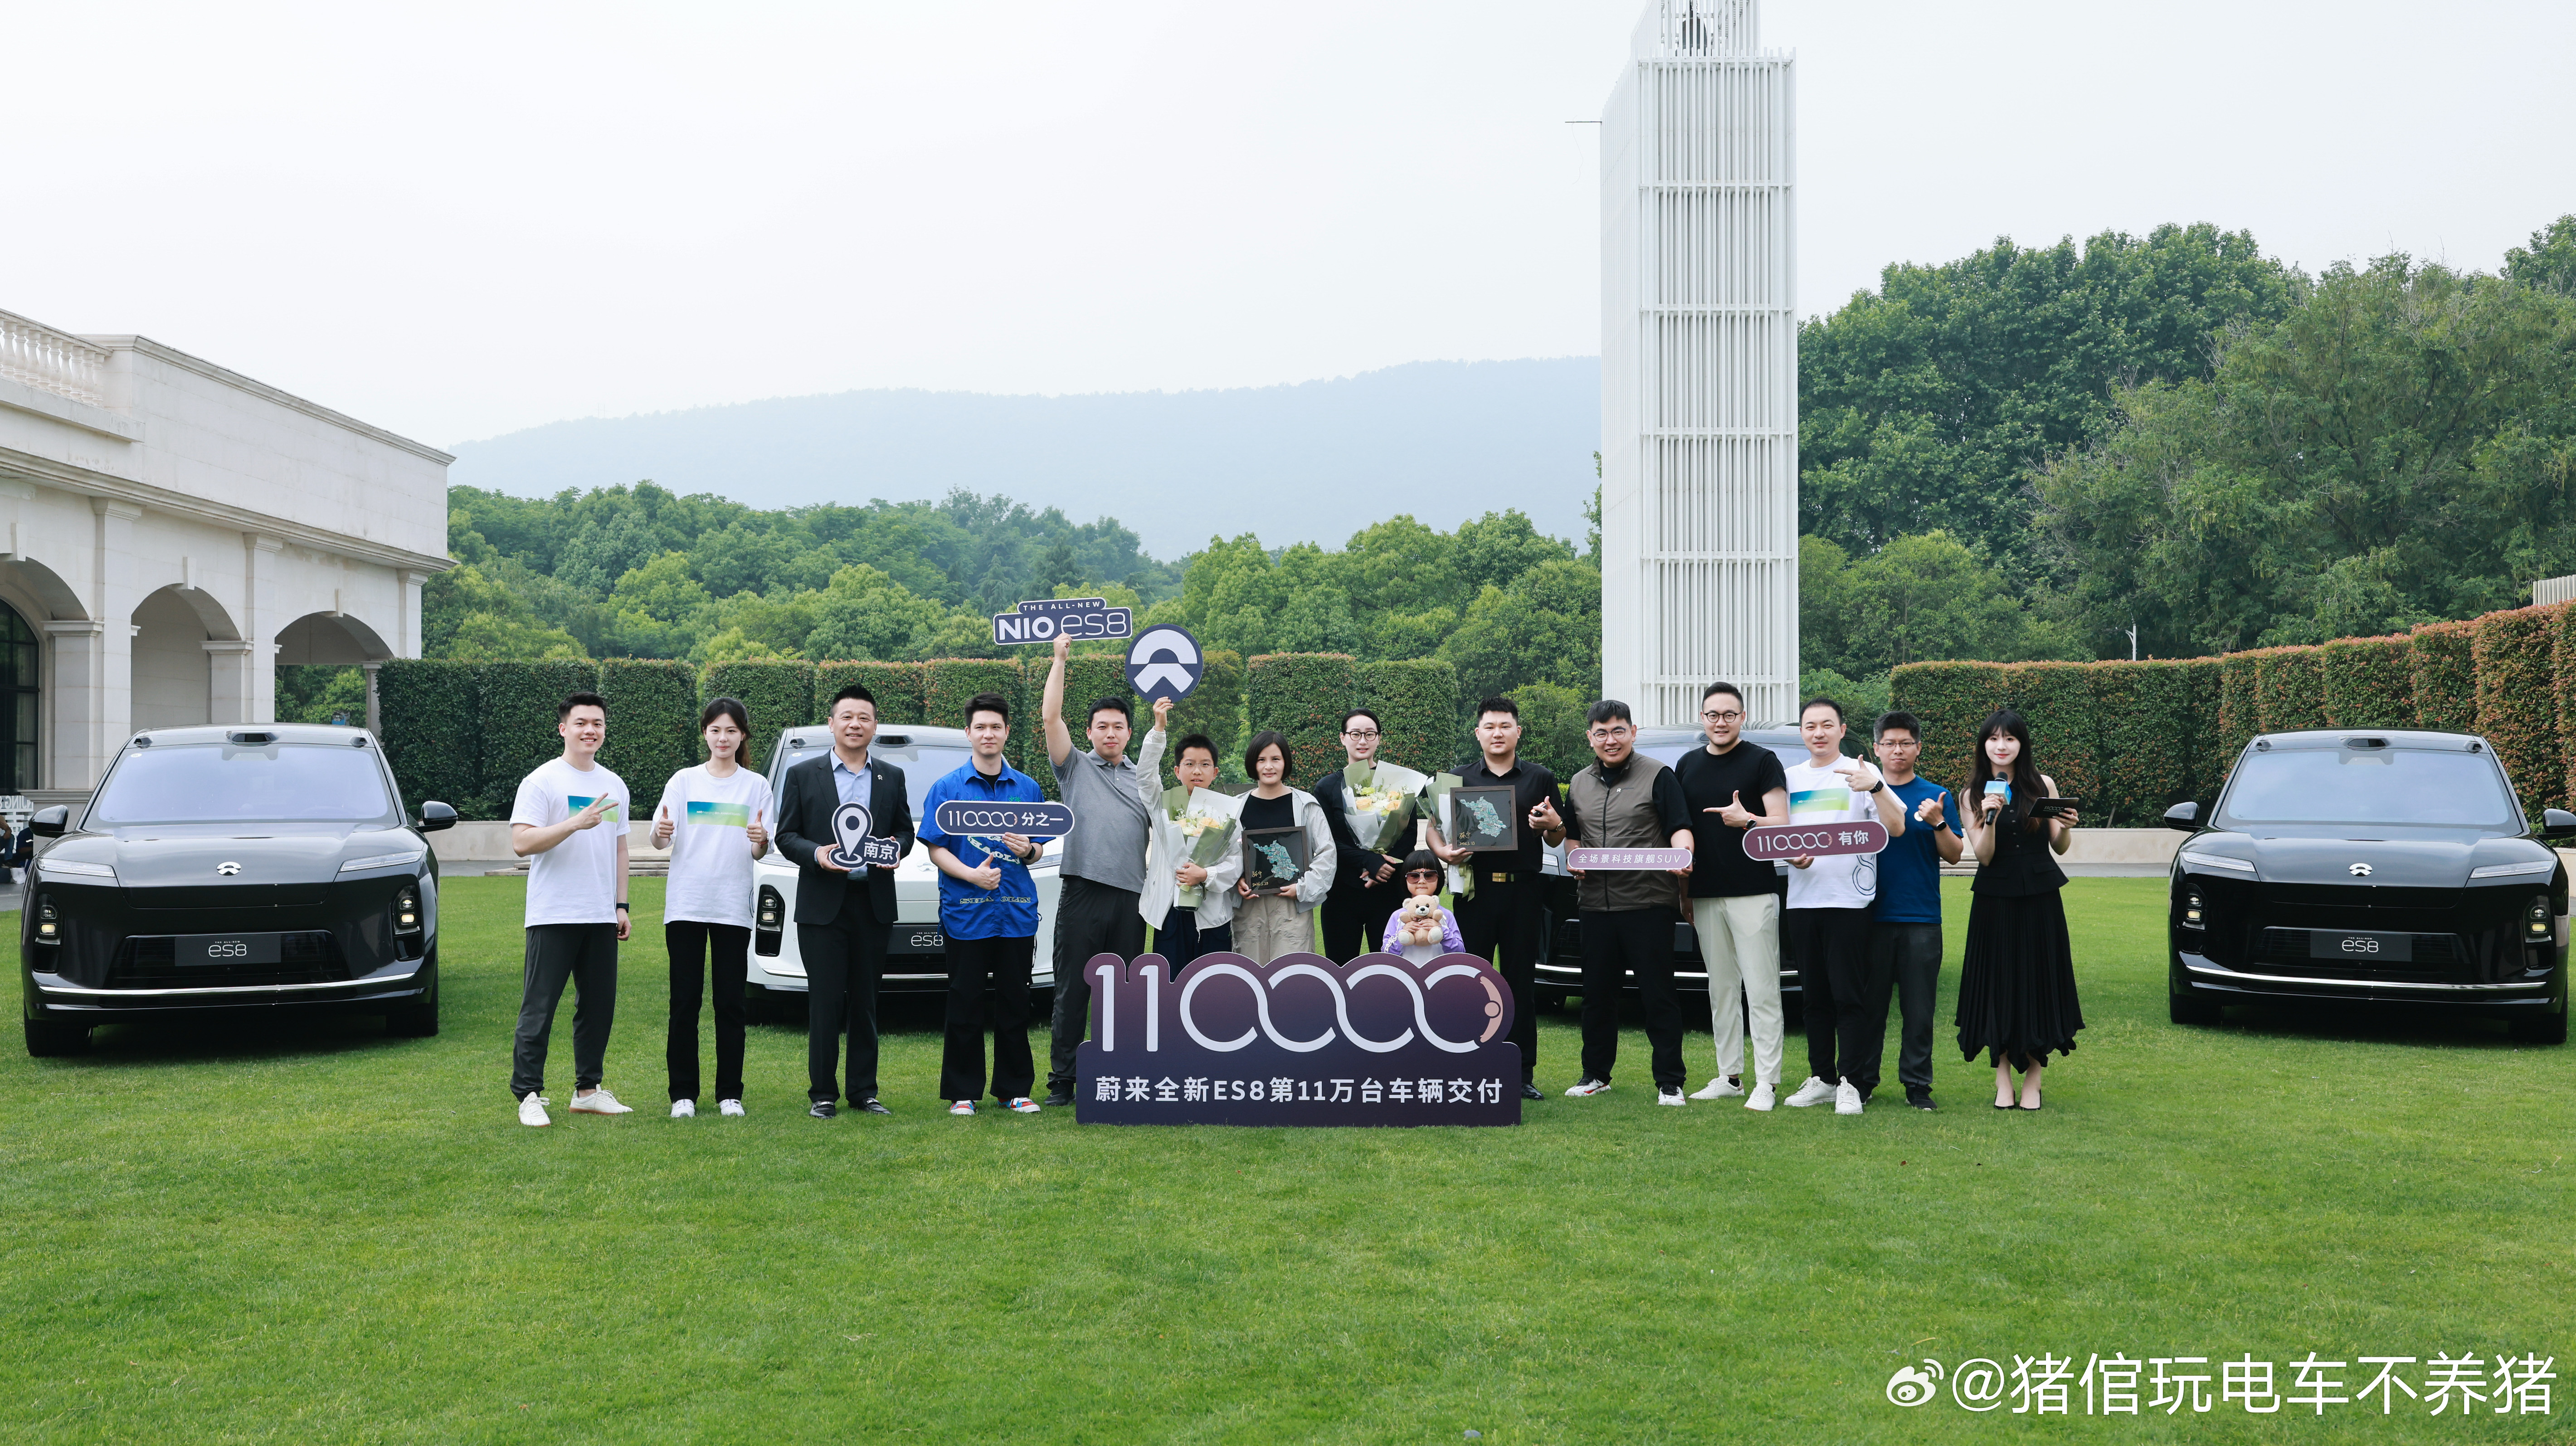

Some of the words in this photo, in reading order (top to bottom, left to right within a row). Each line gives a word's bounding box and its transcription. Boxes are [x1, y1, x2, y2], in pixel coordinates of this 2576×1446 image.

[1050, 601, 1101, 610] ALL-NEW
[998, 616, 1055, 640] NIO
[1021, 812, 1064, 826] 分之一
[1838, 830, 1869, 846] 有你
[863, 842, 895, 860] 南京
[1578, 853, 1681, 864] 全场景科技旗舰SUV
[1095, 963, 1504, 1053] 110000
[1095, 1076, 1503, 1104] 蔚来全新ES8第11万台车辆交付
